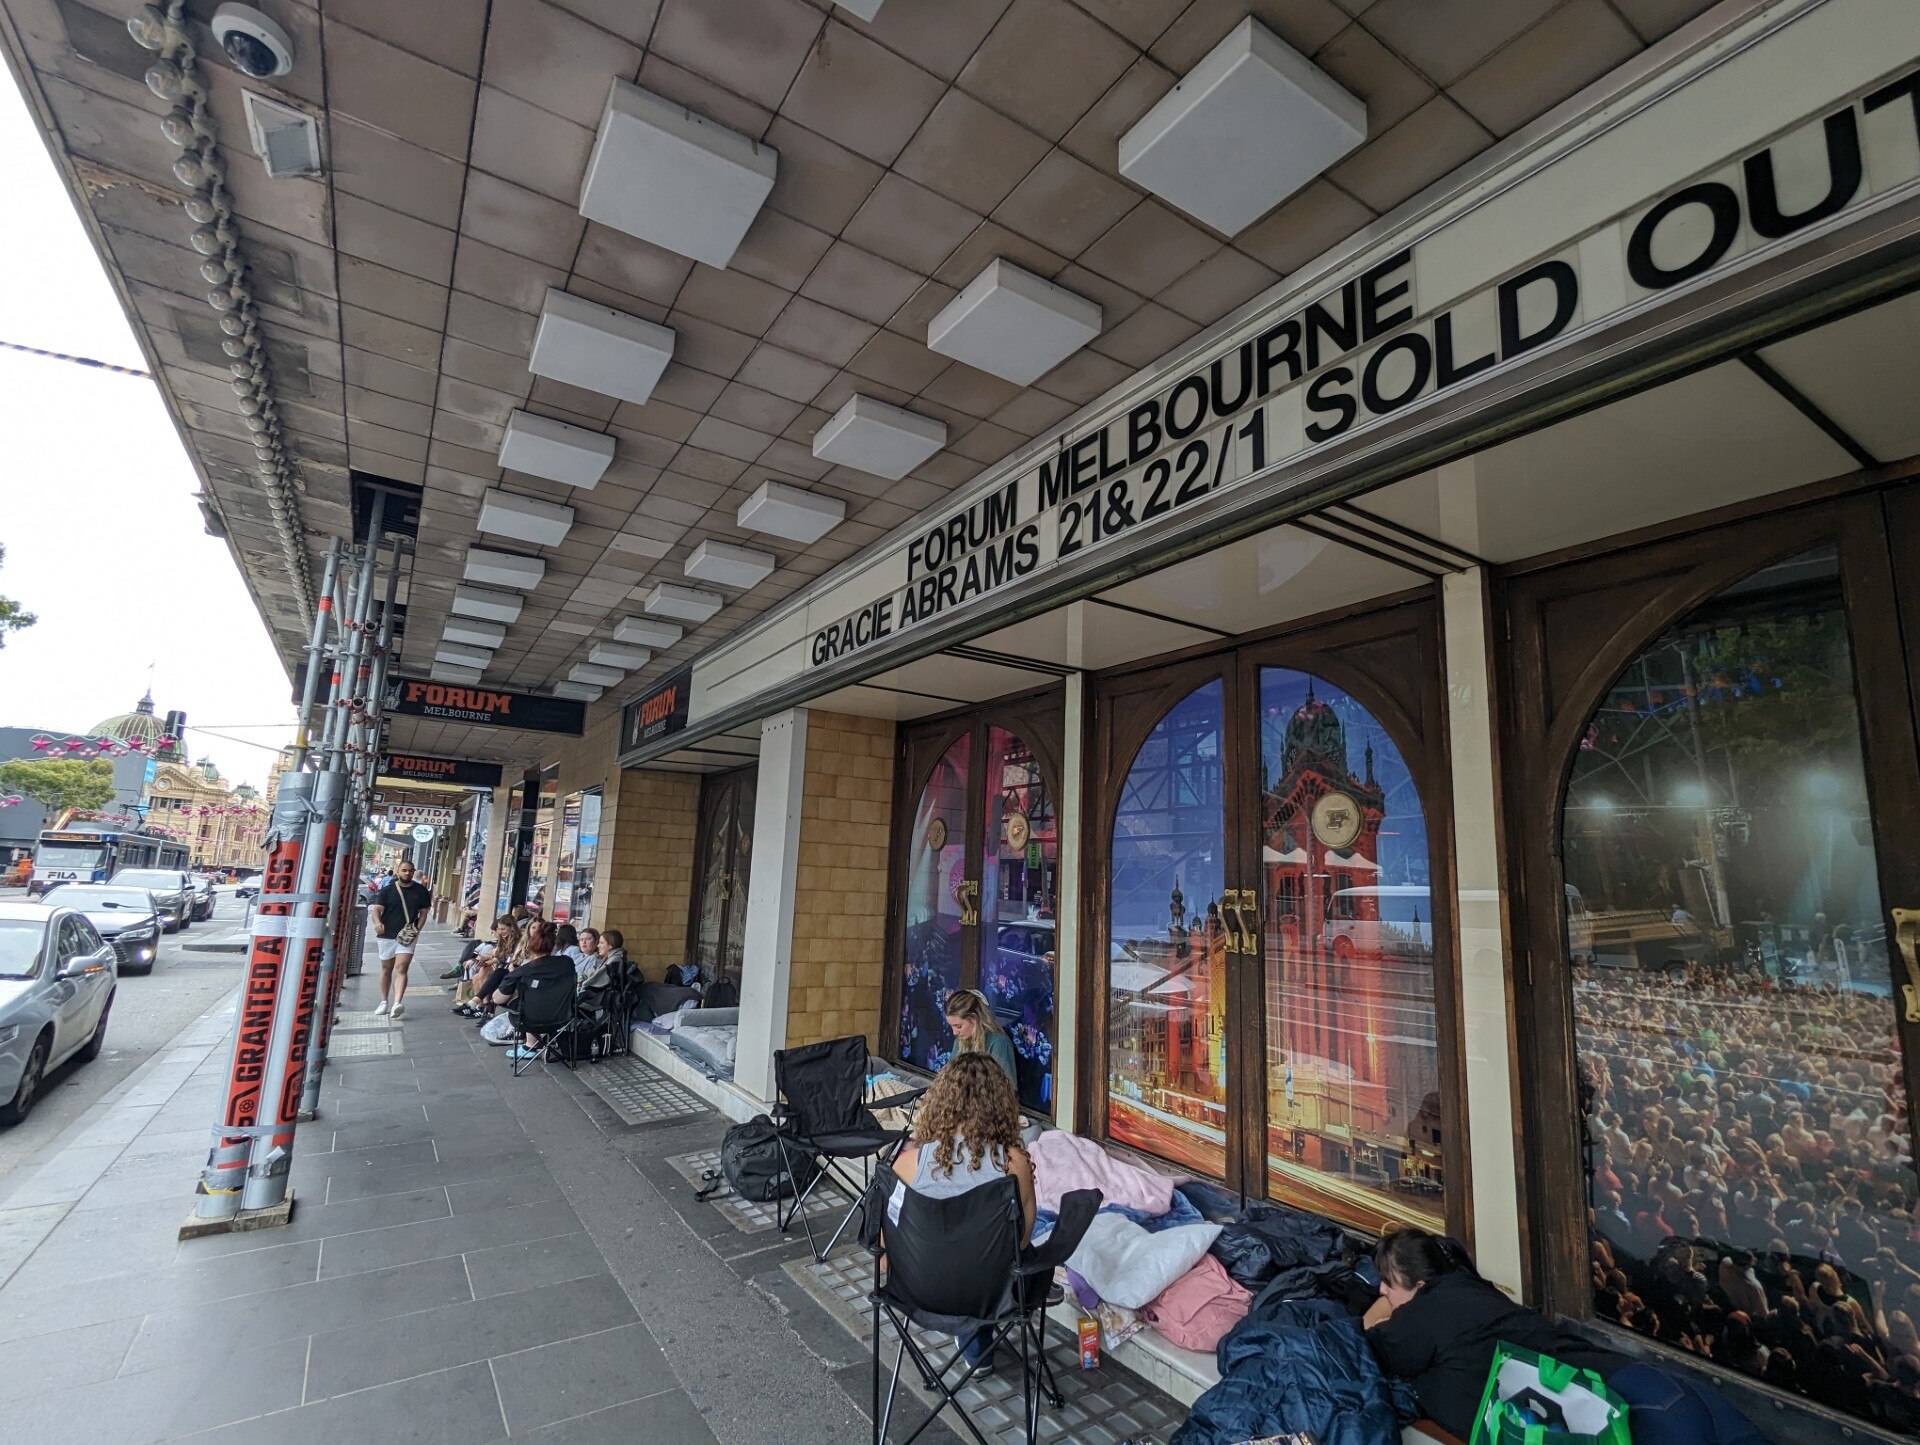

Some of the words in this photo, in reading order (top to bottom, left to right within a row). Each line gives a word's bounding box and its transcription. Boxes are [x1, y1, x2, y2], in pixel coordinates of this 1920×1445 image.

[812, 596, 893, 667] GRACIE
[899, 525, 1039, 629] ABRAMS
[1059, 406, 1265, 559] 21&22/1
[1304, 260, 1579, 444] SOLD
[1627, 68, 1920, 290] OU
[907, 480, 1018, 582] FORUM
[1038, 248, 1414, 513] MELBOURNE
[405, 682, 512, 714] FORUM
[640, 685, 677, 729] FORUM
[424, 706, 492, 721] MELBOURNE
[391, 757, 457, 774] FORUM
[402, 770, 444, 779] MELBOURNE
[392, 806, 452, 818] MOVIDA
[394, 815, 419, 823] NEXT
[424, 817, 448, 825] DOOR
[1325, 809, 1350, 829] F
[48, 871, 77, 879] FILA
[256, 858, 295, 956] ACSS
[236, 963, 278, 1083] GRANTED
